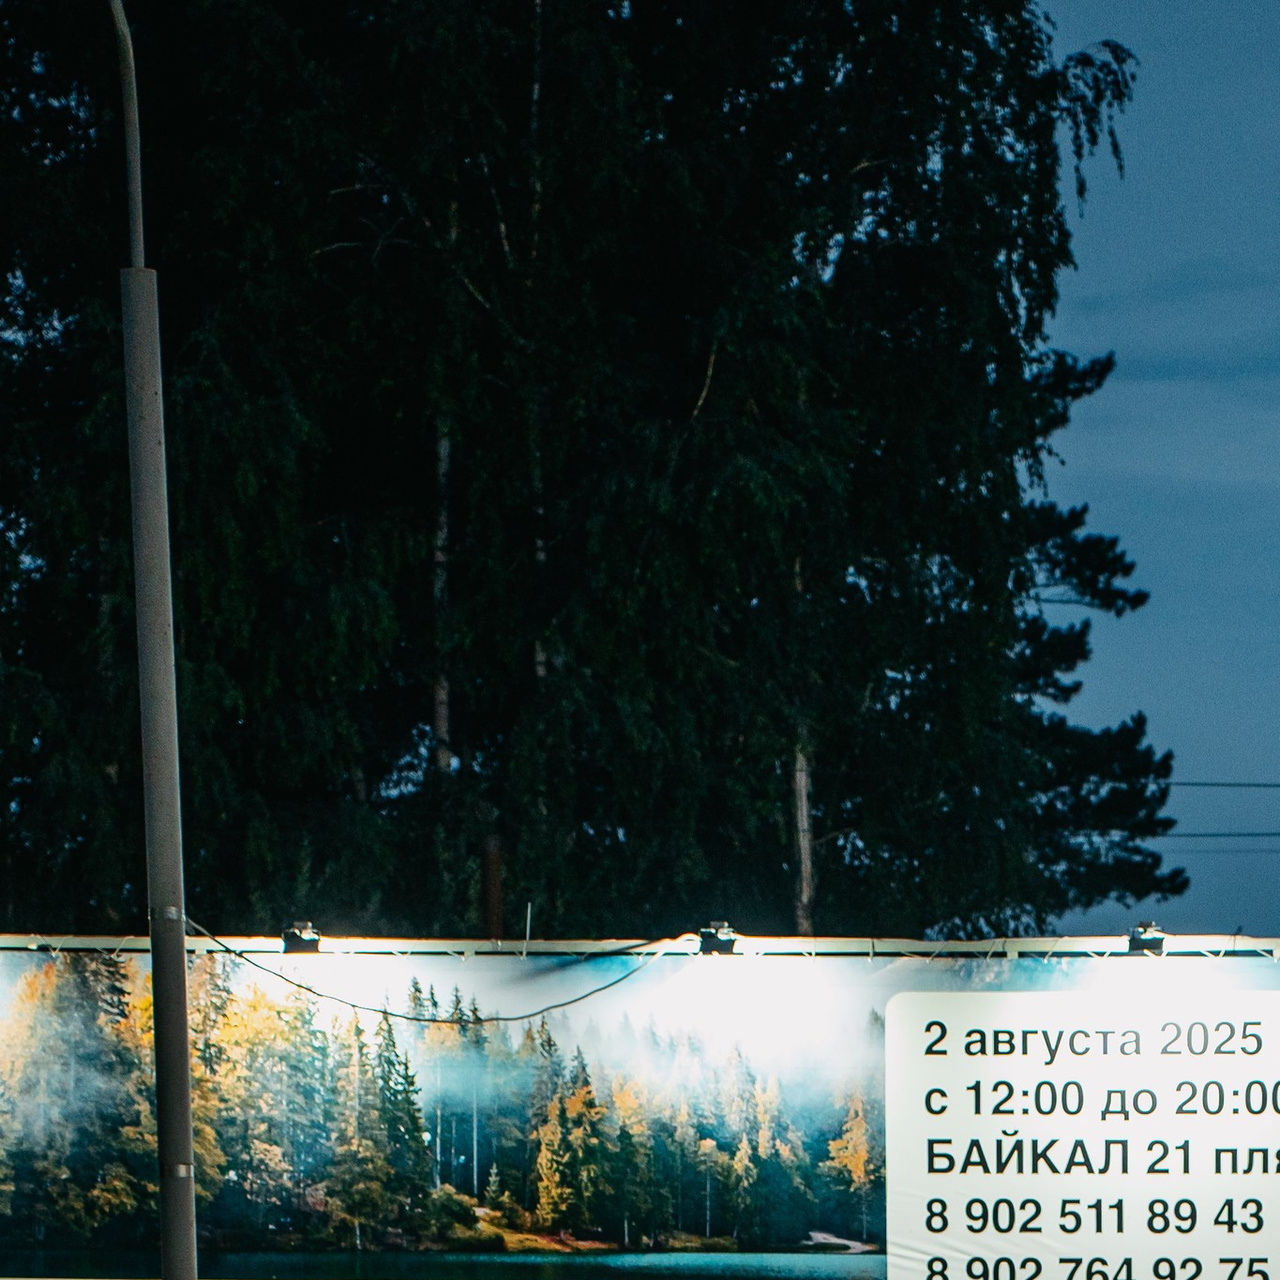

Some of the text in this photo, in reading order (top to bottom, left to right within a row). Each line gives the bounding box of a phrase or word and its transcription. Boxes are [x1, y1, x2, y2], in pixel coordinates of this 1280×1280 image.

[924, 1020, 1263, 1066] 2 августа 2025
[924, 1088, 948, 1116] с
[966, 1080, 1084, 1116] 12:00
[1101, 1088, 1158, 1121] до
[926, 1129, 1129, 1175] БАЙКАЛ
[1146, 1139, 1190, 1175] 21
[925, 1198, 1265, 1234] 8 902 511 89 43
